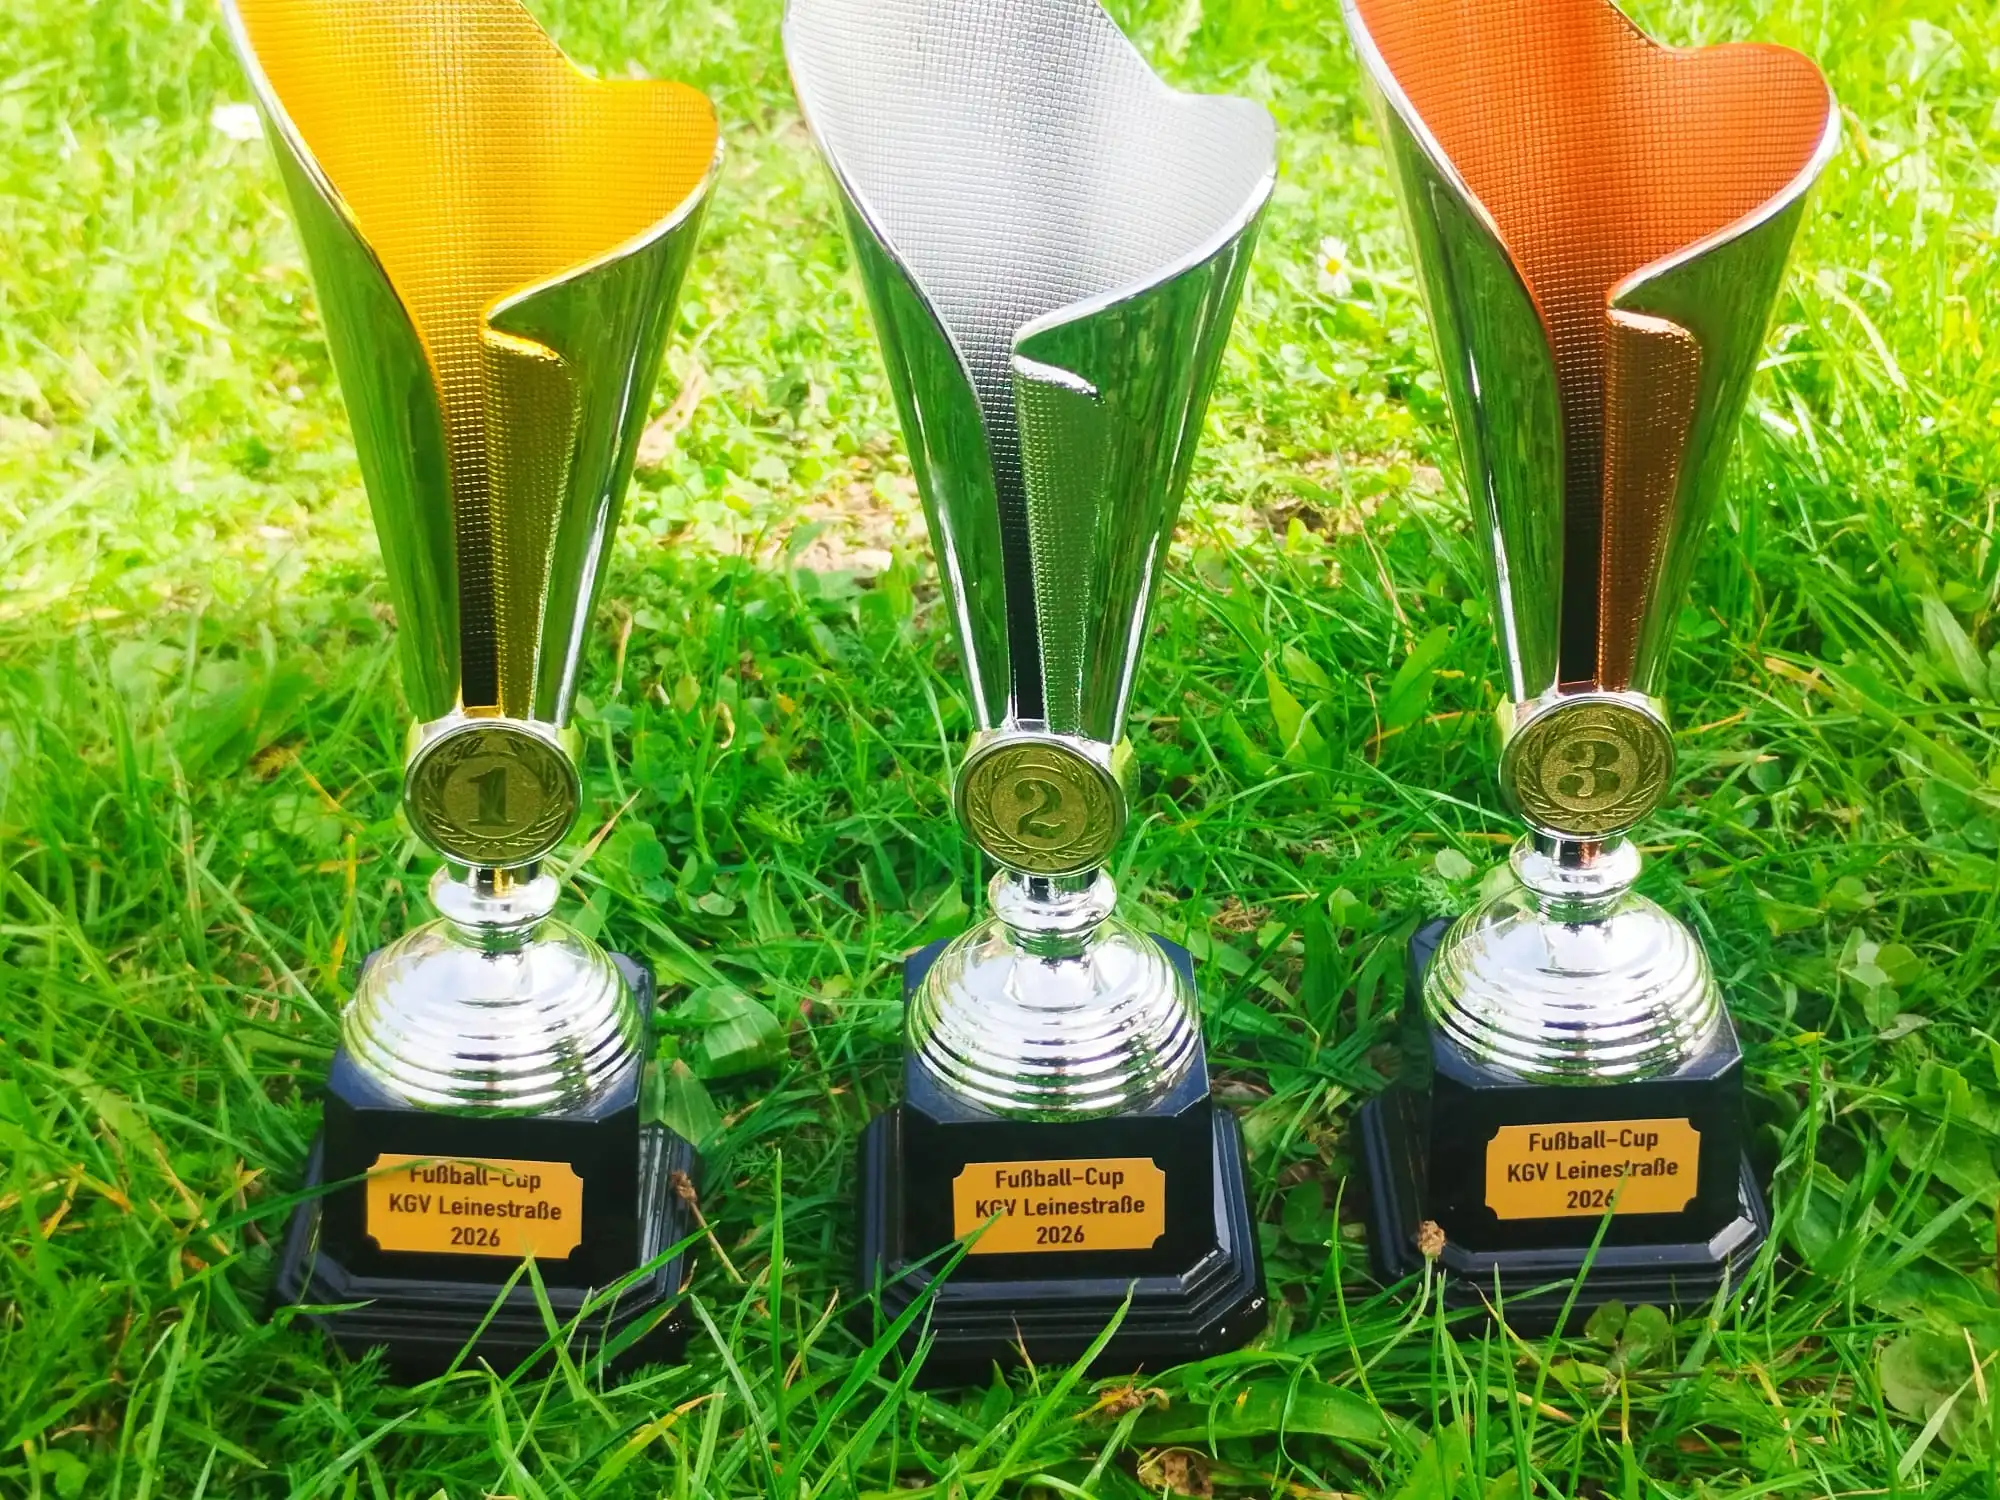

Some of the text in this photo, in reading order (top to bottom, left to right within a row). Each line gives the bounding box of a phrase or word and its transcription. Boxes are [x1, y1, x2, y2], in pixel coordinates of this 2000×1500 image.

[1557, 739, 1621, 798] 3
[468, 766, 516, 827] 1
[1014, 778, 1067, 839] 2
[1528, 1129, 1658, 1151] Fußball-Cup
[409, 1163, 541, 1193] Fußball-Cup
[995, 1167, 1124, 1189] Fußball-Cup
[1507, 1162, 1548, 1182] KGV
[389, 1193, 562, 1221] KGV Leinestraße
[976, 1195, 1145, 1218] KGV Leinestraße
[450, 1226, 501, 1247] 2026
[1036, 1225, 1085, 1244] 2026
